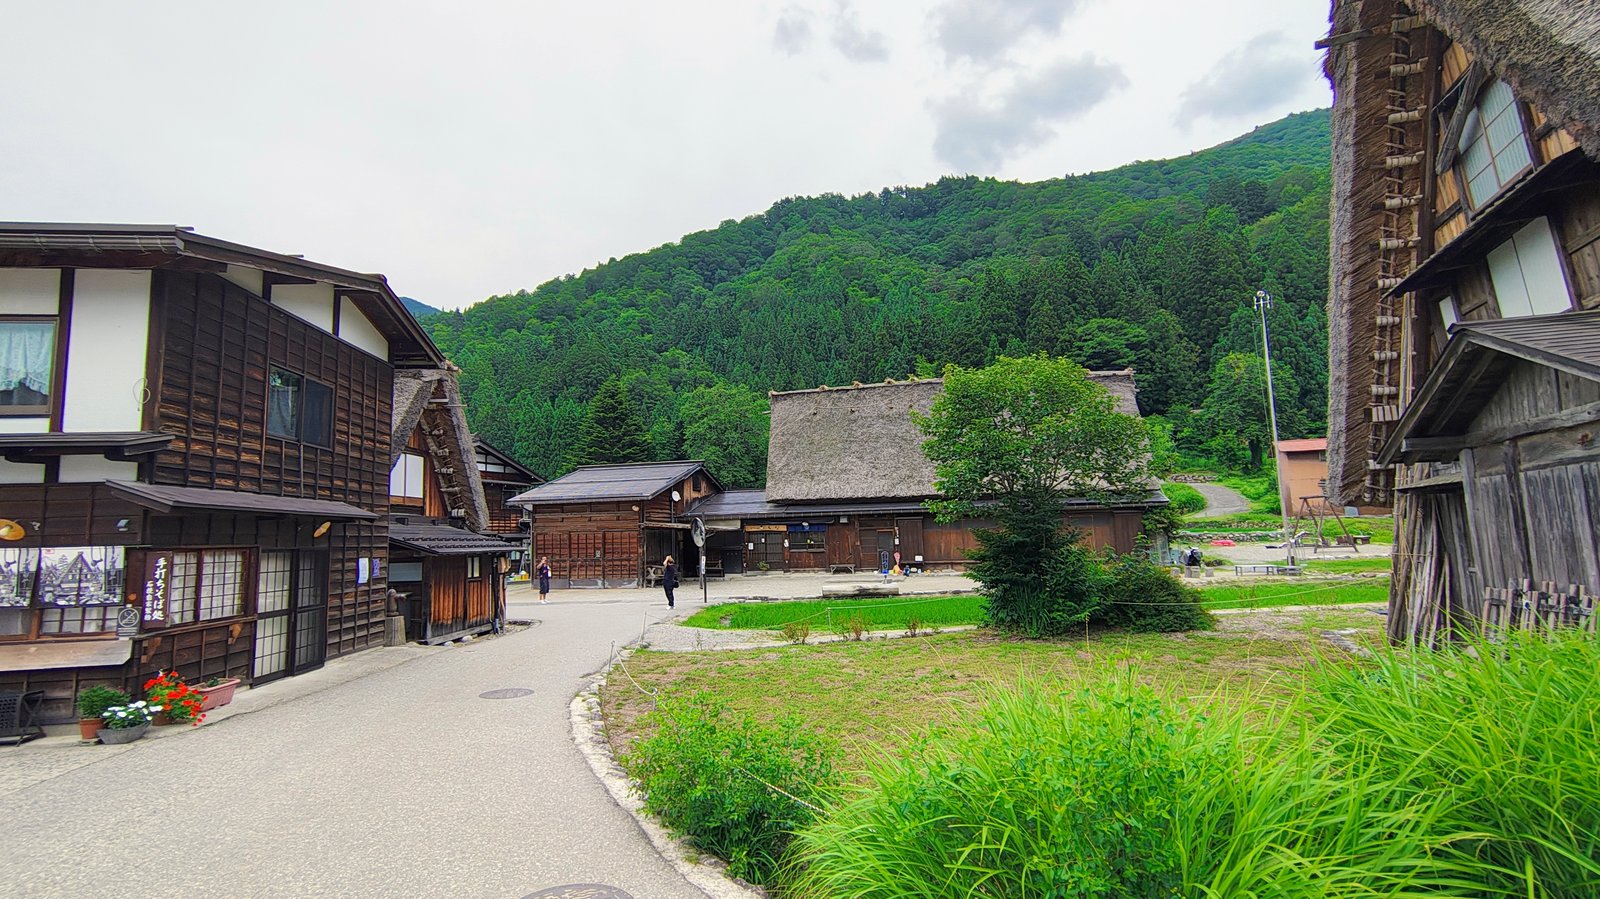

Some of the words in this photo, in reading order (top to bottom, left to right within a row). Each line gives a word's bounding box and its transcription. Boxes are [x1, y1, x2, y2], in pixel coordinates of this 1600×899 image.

[152, 557, 167, 620] 手打ちそば処
